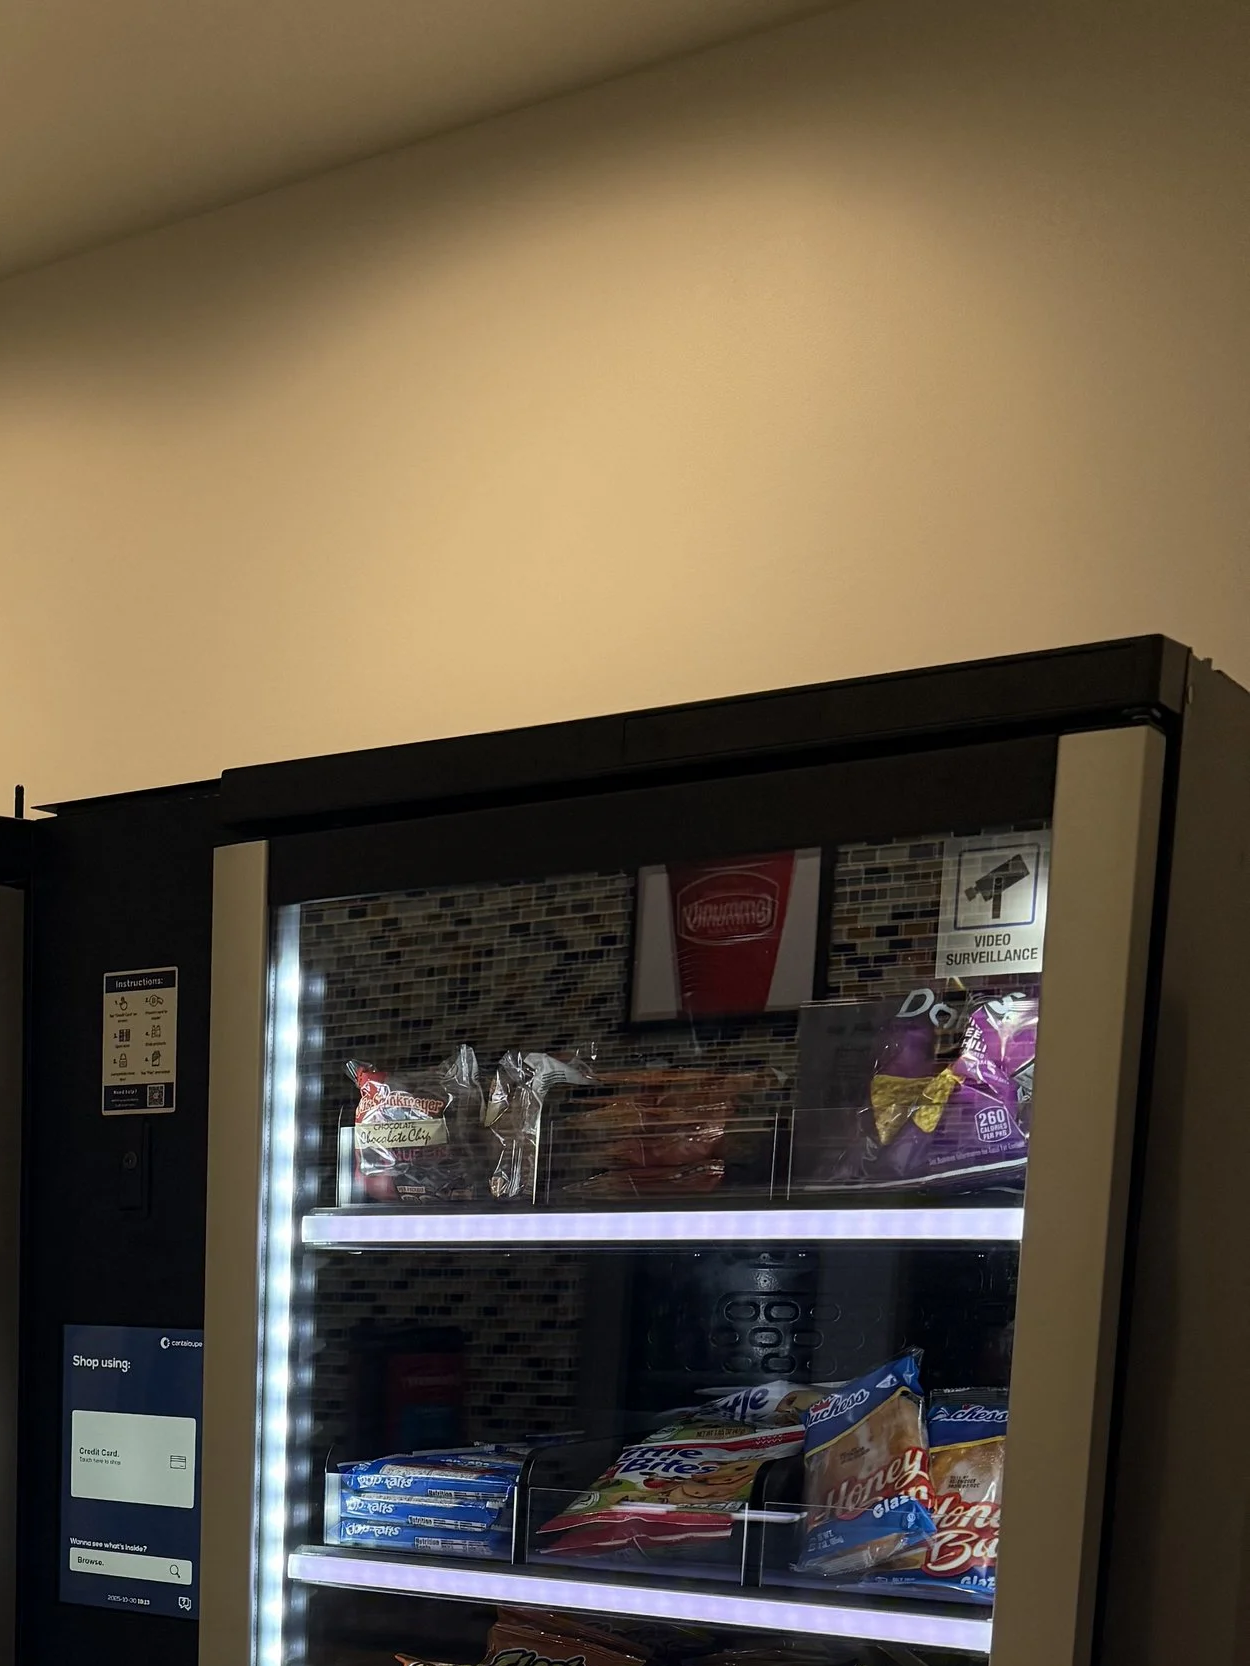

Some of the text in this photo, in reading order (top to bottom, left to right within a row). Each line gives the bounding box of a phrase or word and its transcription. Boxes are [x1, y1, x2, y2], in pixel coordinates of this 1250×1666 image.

[974, 933, 1011, 947] VIDEO
[946, 947, 1038, 966] SURVEILLANCE
[960, 1037, 987, 1053] HILI
[374, 1121, 416, 1131] CHOCOLATE
[979, 1109, 1006, 1127] 260
[980, 1122, 1008, 1134] CALORIES
[360, 1128, 432, 1150] Chocolate Chip
[72, 1354, 131, 1373] Shop using:
[79, 1447, 120, 1458] Credit Card.
[69, 1537, 92, 1547] Wanna
[103, 1542, 125, 1550] what's
[125, 1544, 148, 1553] inside?
[77, 1556, 105, 1566] Browse.
